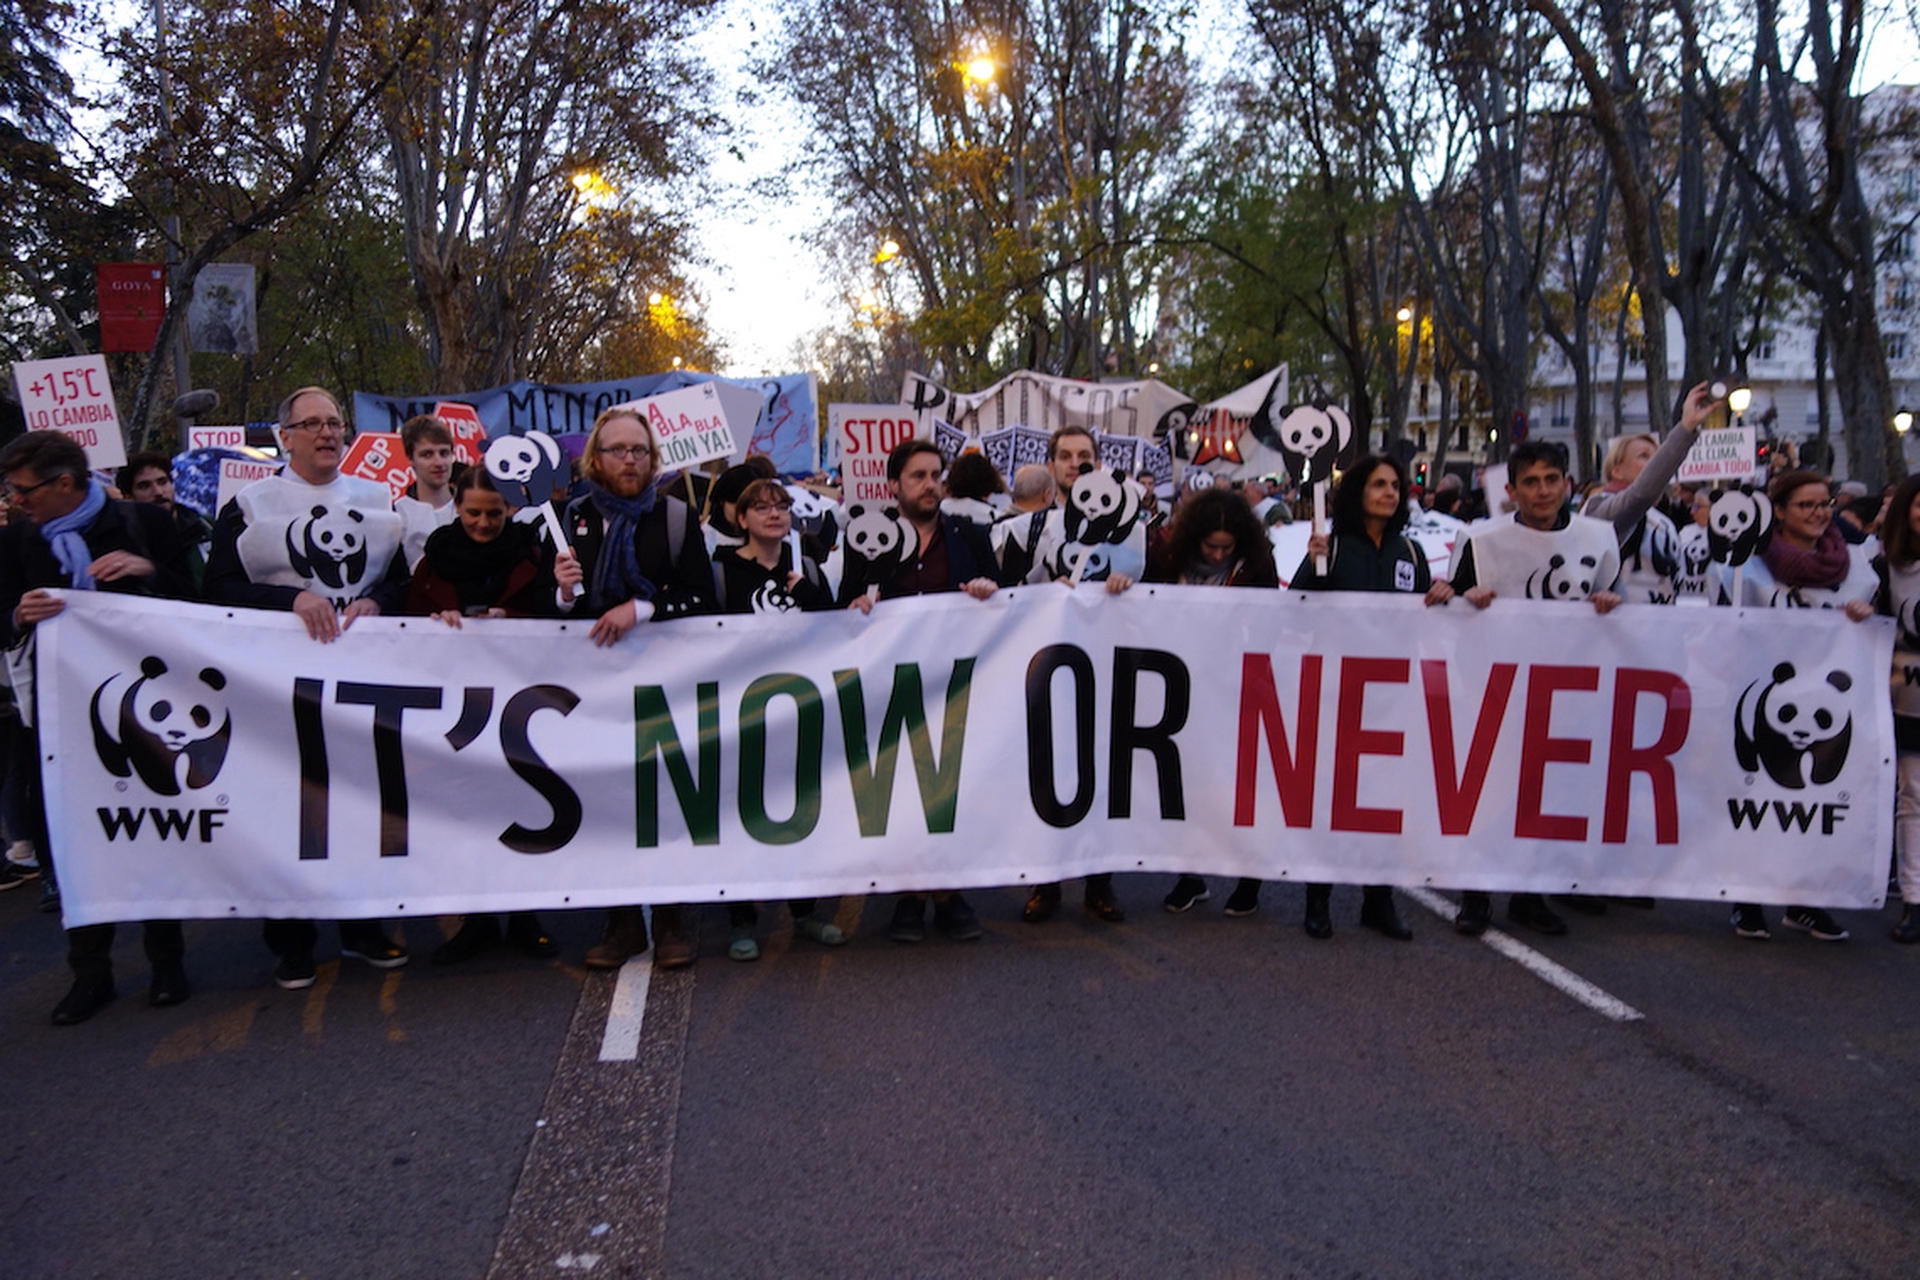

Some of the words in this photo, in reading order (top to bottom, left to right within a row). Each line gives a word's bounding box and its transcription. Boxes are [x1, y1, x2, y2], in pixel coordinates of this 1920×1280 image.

[112, 281, 151, 291] GOYA
[29, 410, 50, 429] LO
[52, 404, 114, 427] CAMBIA
[656, 413, 692, 437] BLA
[694, 415, 722, 433] BLA
[192, 431, 242, 449] STOP
[698, 428, 732, 453] YA!
[843, 418, 915, 455] STOP
[1016, 435, 1048, 455] SOS
[1704, 431, 1744, 447] CAMBIA
[354, 436, 392, 480] TOP
[1100, 442, 1133, 460] SOS
[1692, 449, 1703, 463] EL
[851, 459, 886, 478] CLIM
[1681, 462, 1721, 477] CAMBIA
[1725, 460, 1752, 473] TODO
[856, 481, 896, 500] CHAN
[292, 677, 584, 860] IT'S
[634, 656, 978, 848] NOW
[1025, 643, 1191, 829] OR
[1233, 652, 1693, 845] NEVER
[97, 806, 229, 844] WWF
[1727, 797, 1850, 835] WWF
